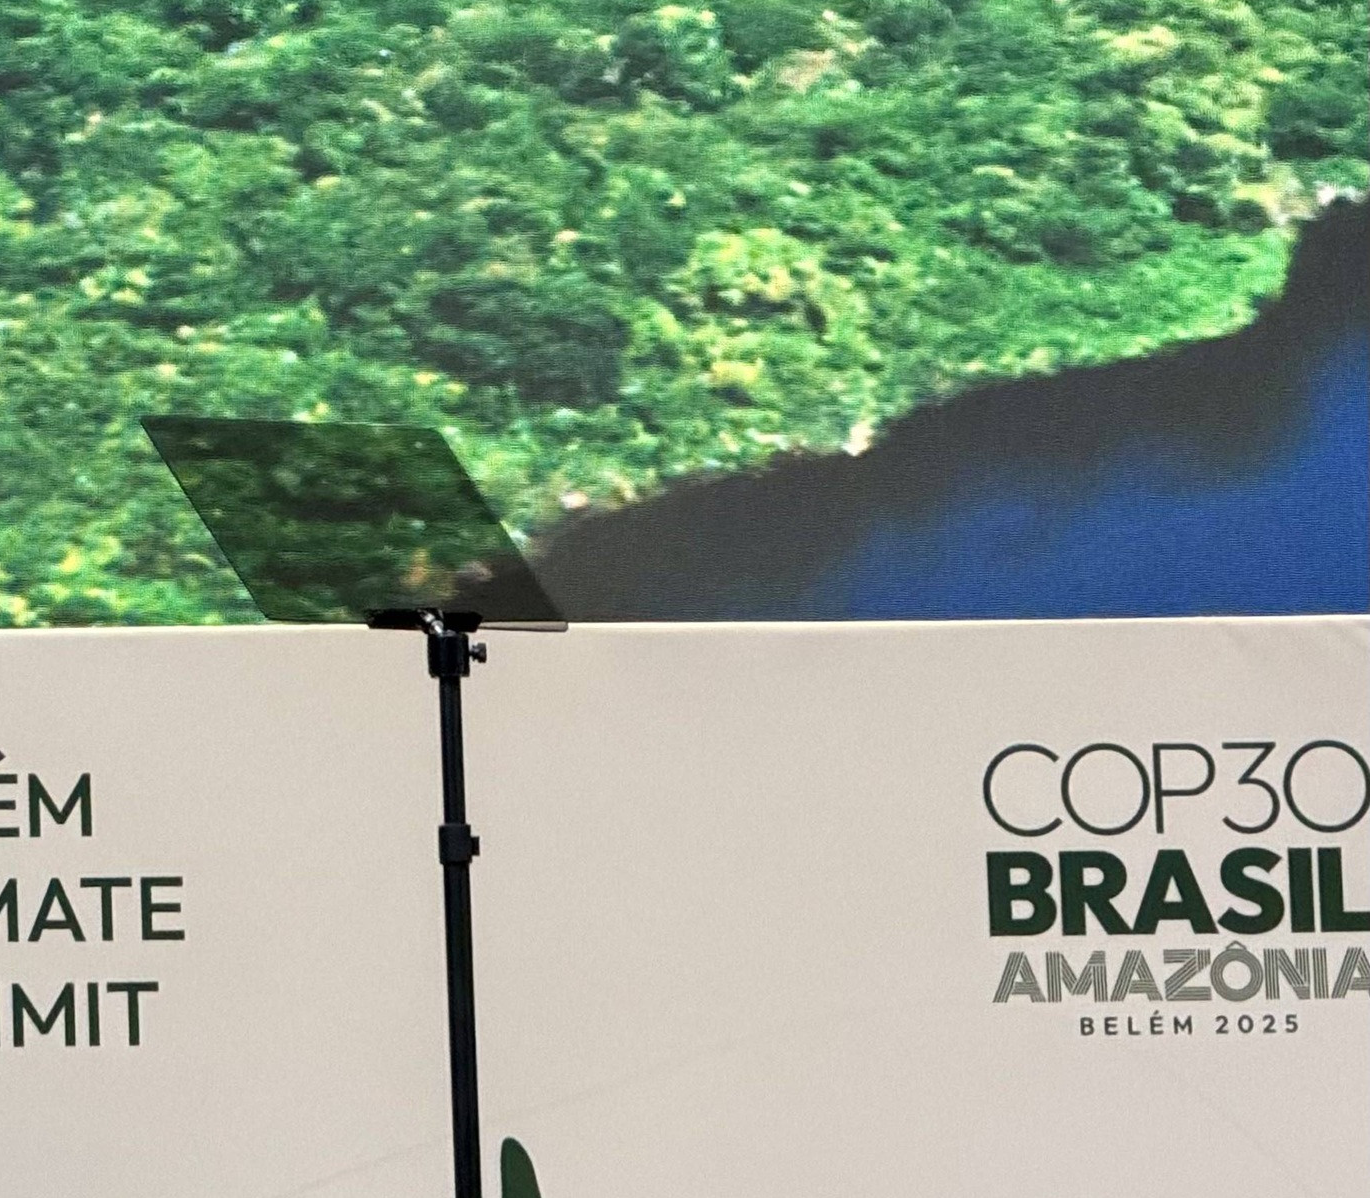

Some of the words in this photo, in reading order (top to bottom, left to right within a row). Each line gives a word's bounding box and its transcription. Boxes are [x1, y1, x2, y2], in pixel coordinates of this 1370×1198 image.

[983, 740, 1370, 837] COP30
[986, 847, 1370, 937] BRASIL
[992, 940, 1370, 1003] AMAZÔNIA
[1080, 1010, 1193, 1036] BELÉM
[1215, 1013, 1299, 1035] 2025
